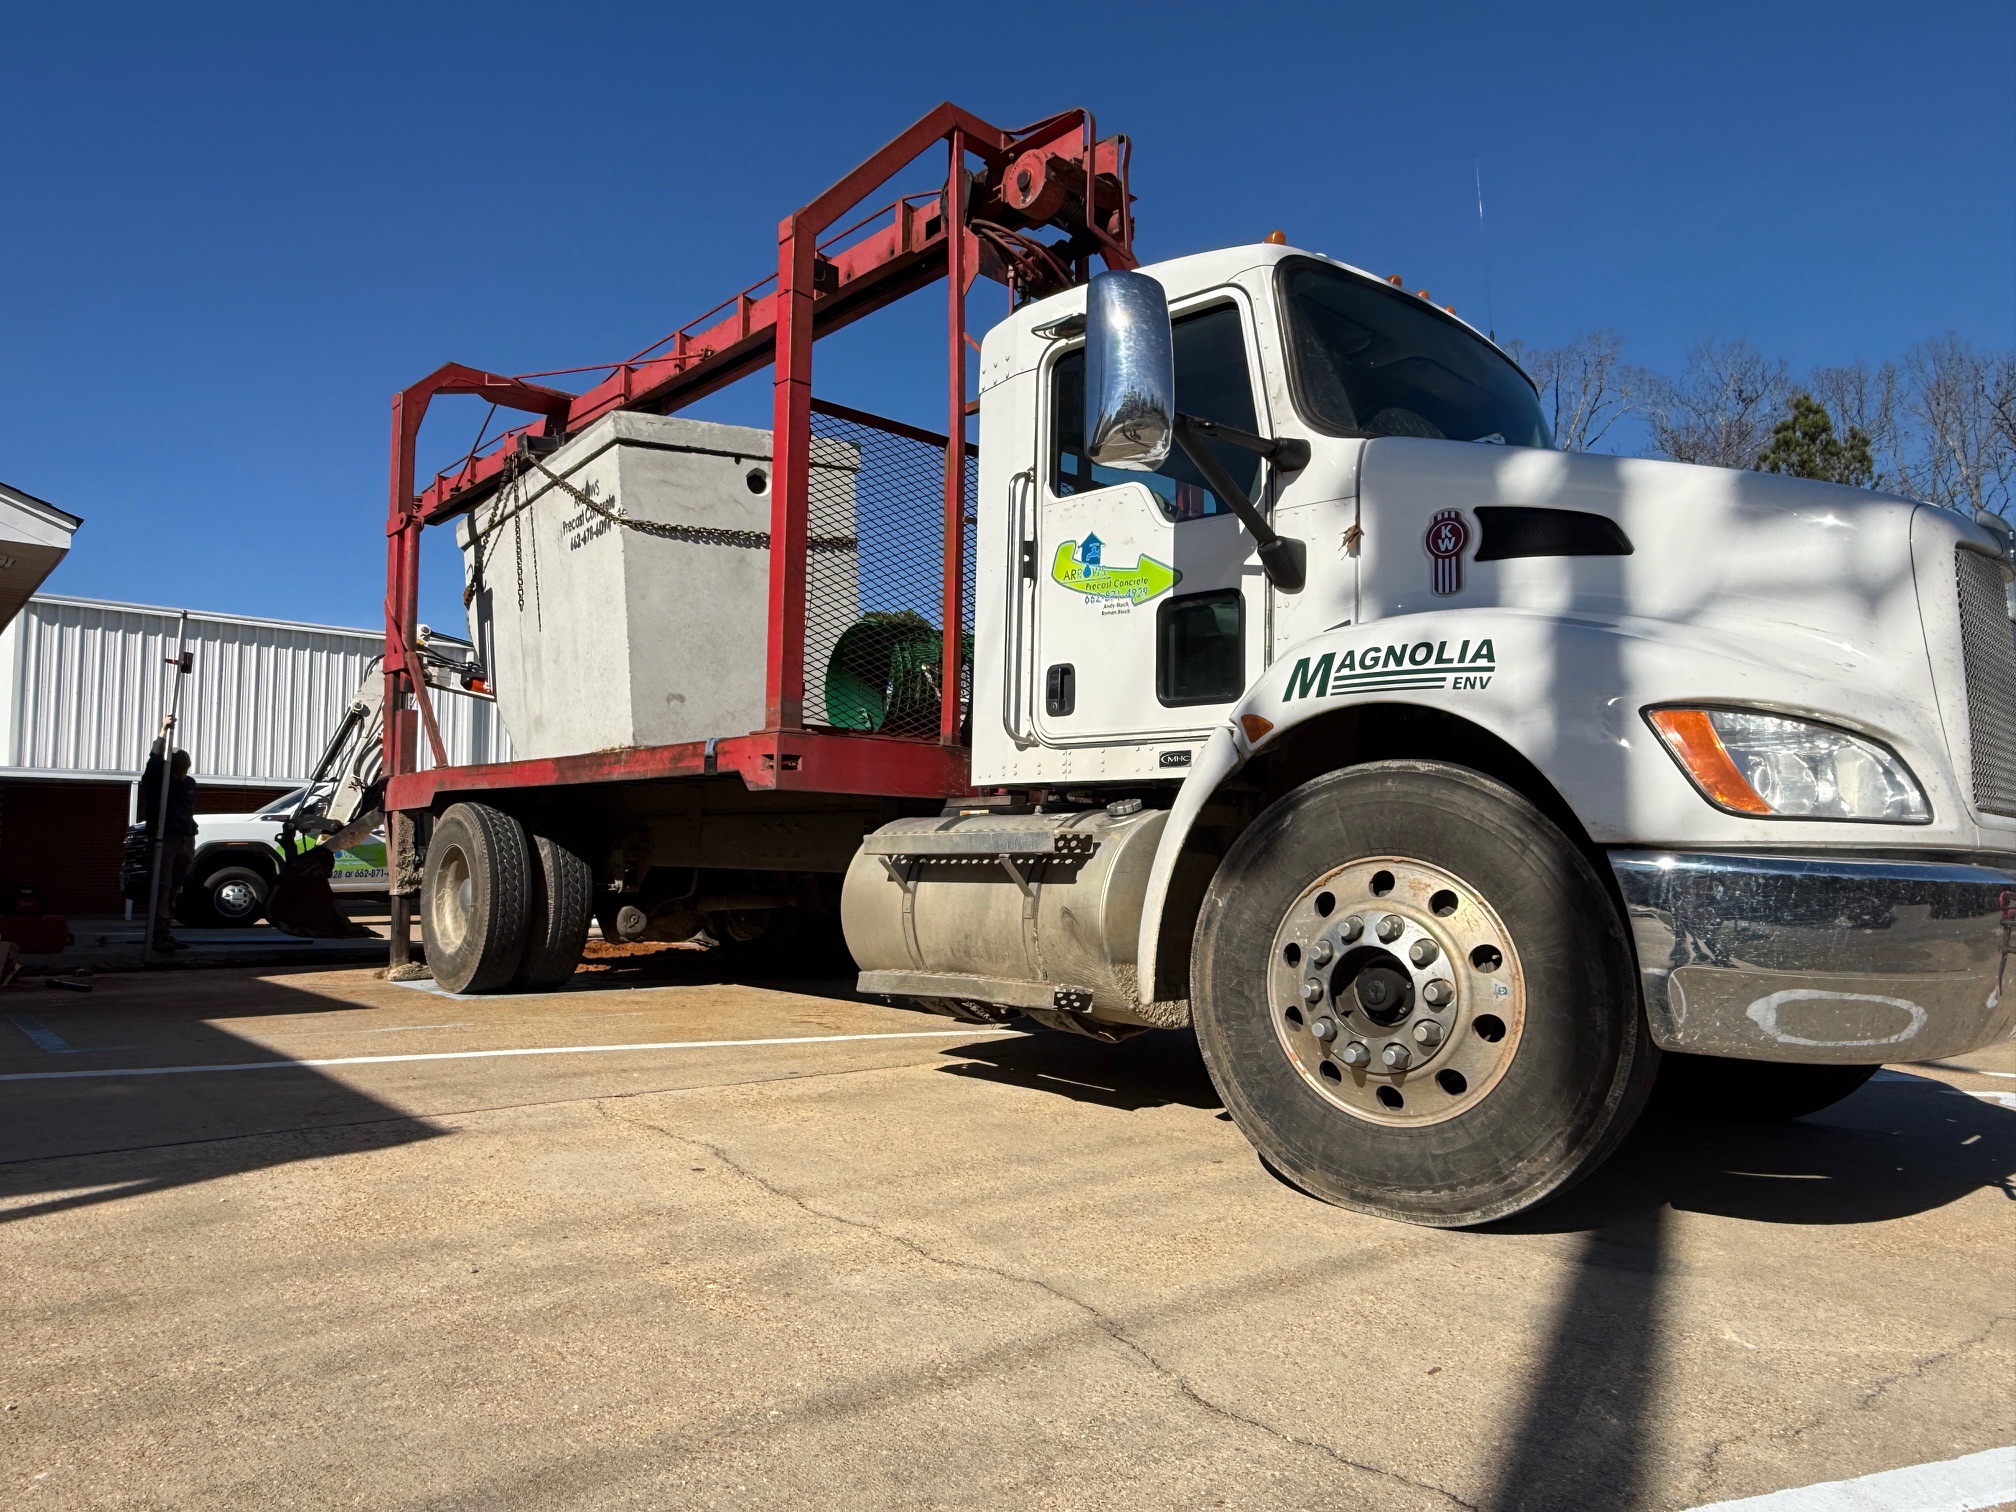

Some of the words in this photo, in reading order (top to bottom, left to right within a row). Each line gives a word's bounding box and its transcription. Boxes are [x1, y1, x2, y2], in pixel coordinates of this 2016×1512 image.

[1113, 577, 1149, 588] Concrete
[1281, 639, 1496, 703] MAGNOLIA
[1452, 676, 1493, 690] ENV
